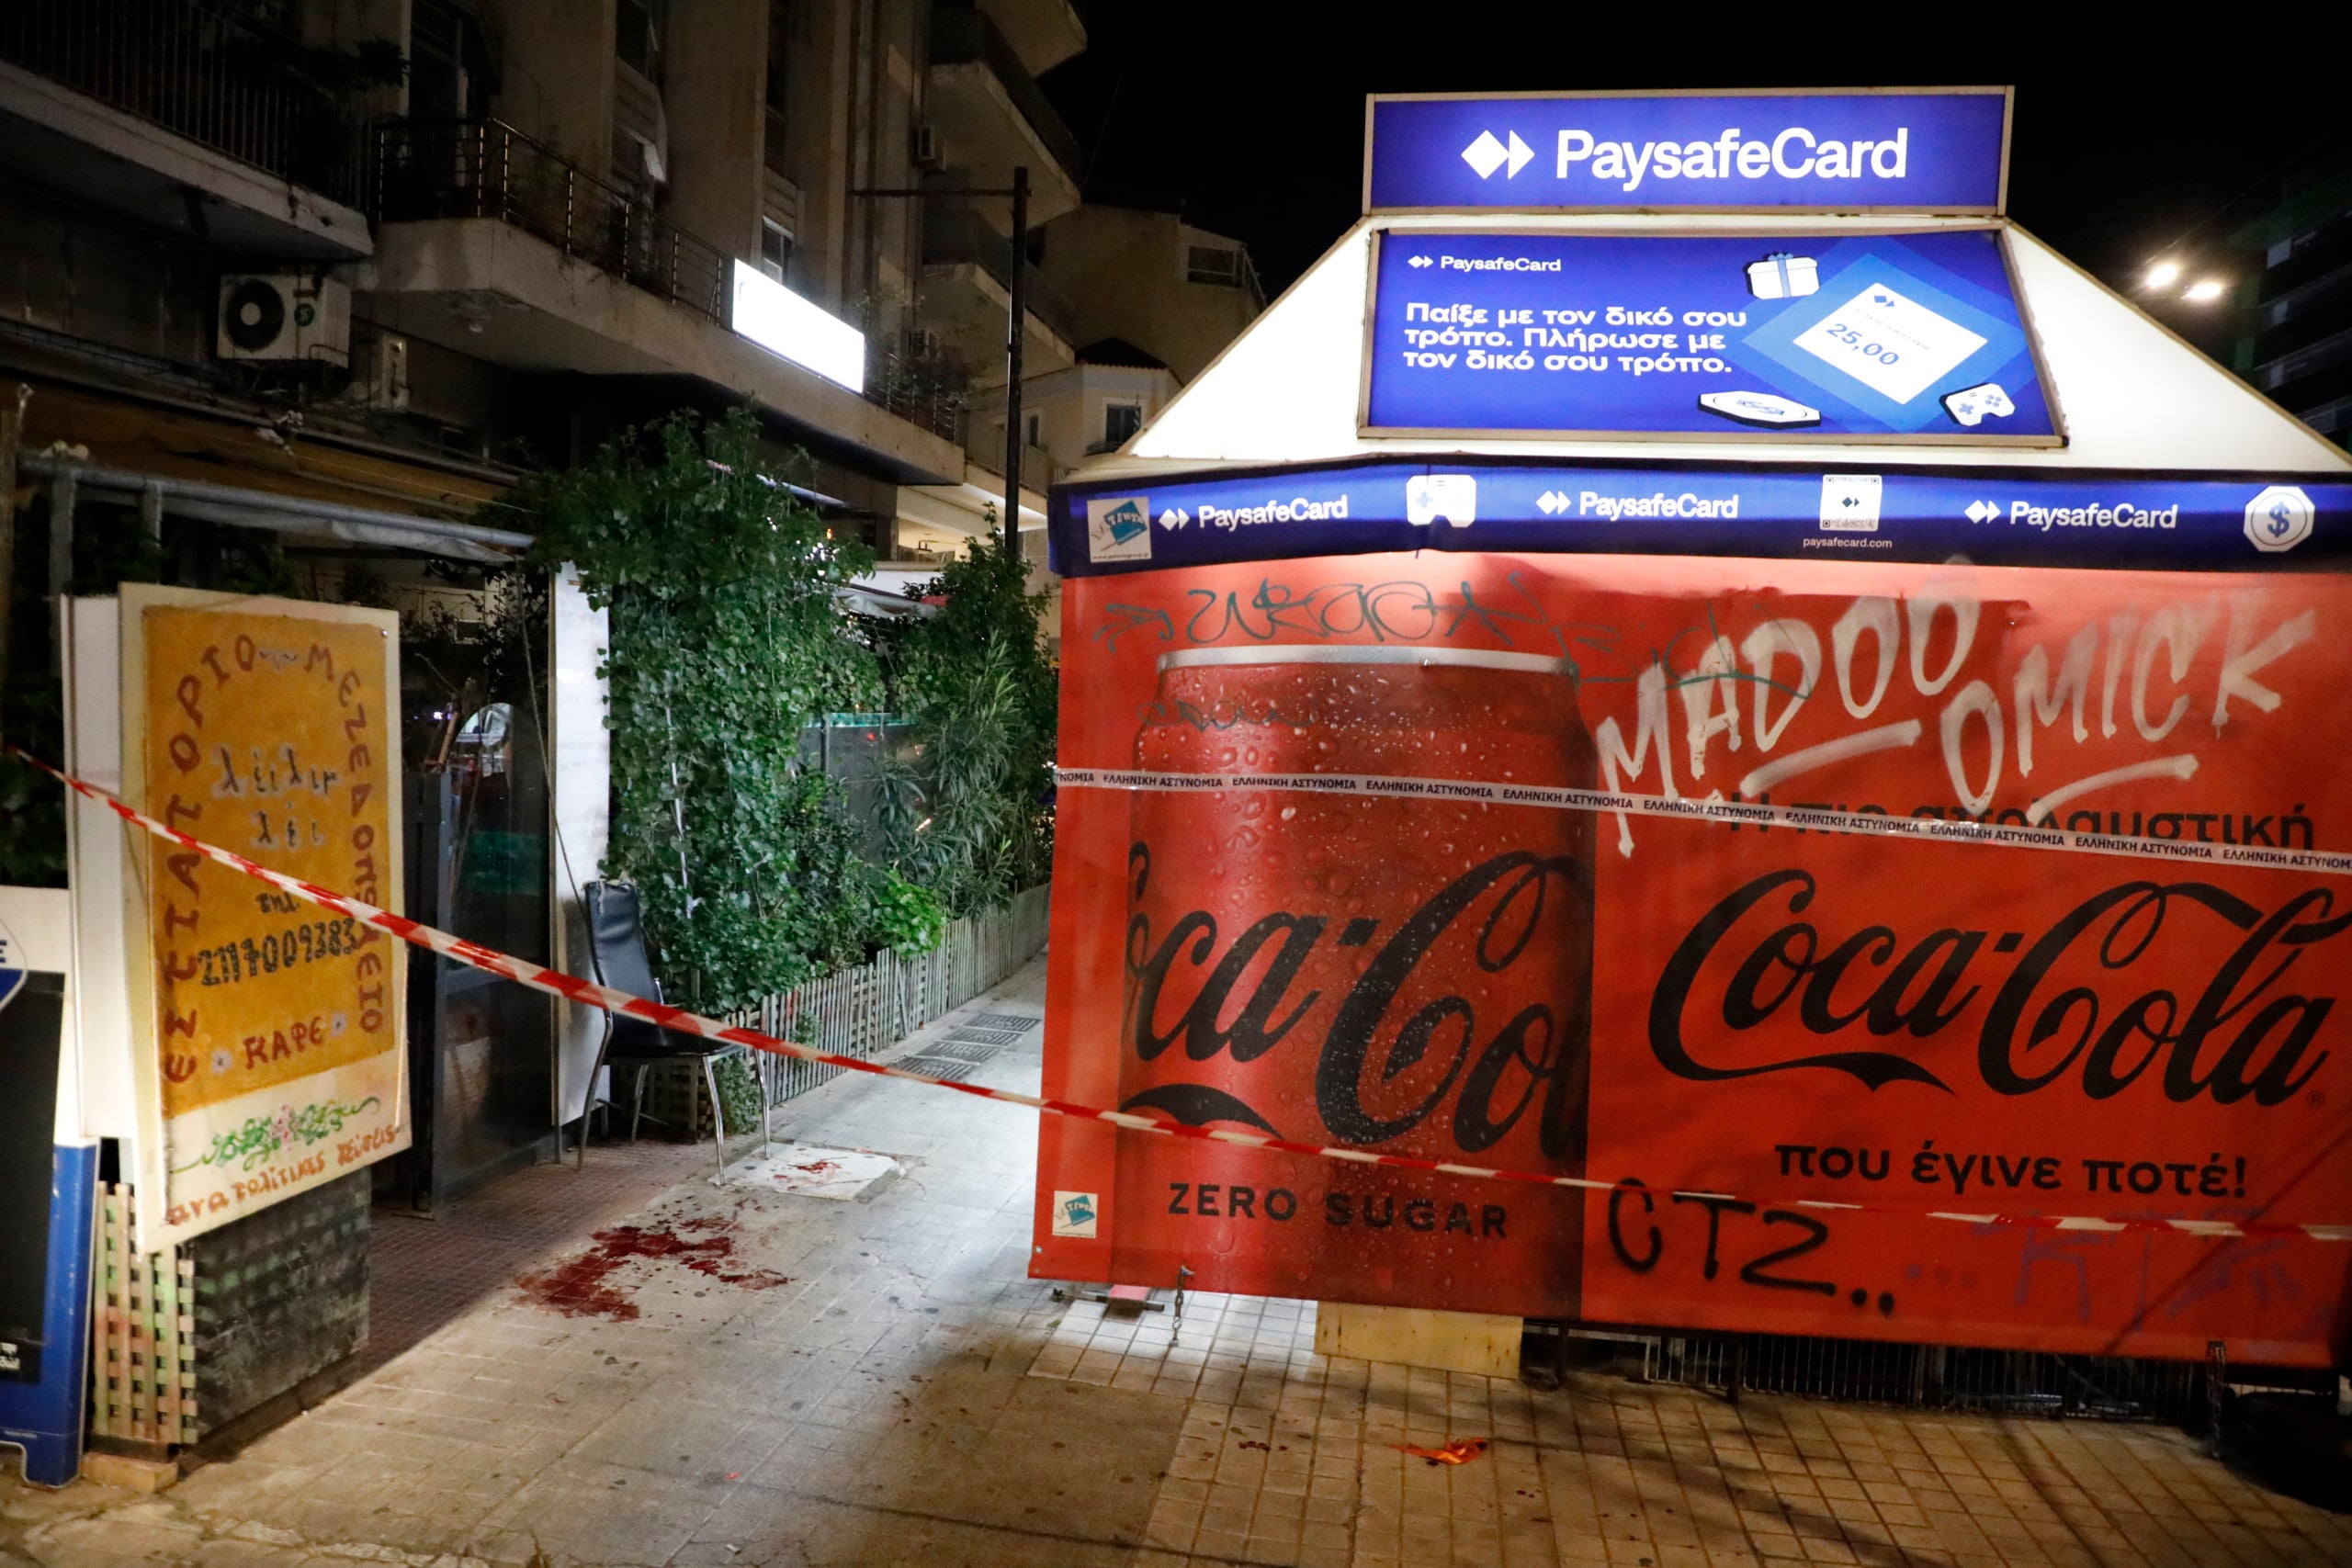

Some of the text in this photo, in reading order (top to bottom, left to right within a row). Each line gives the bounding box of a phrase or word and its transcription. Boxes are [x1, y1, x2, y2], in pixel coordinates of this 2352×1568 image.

[1555, 127, 1908, 191] PaysafeCard
[1440, 254, 1562, 273] PaysafeCard
[1406, 302, 1747, 328] Παίξε με τον δικό σου
[1404, 326, 1726, 353] τρόπο. Πλήρωσε με
[1825, 322, 1900, 366] 25,00
[1403, 349, 1733, 376] τον δικό σου τρόπο.
[1197, 495, 1349, 532] PaysafeCard
[1578, 491, 1739, 523] PaysafeCard
[2009, 502, 2178, 533] PaysafeCard
[1802, 536, 1893, 548] paysafecard.com
[1057, 772, 1094, 783] ΝΟΜΙΑ
[1103, 775, 1156, 786] ΕΛΛΗΝΙΚΗ
[1159, 777, 1223, 788] ΑΣΤΥΝΟΜΙΑ
[1232, 777, 1288, 787] ΕΛΛΗΝΙΚΗ
[1291, 778, 1356, 789] ΑΣΤΥΝΟΜΙΑ
[1366, 781, 1423, 794] ΕΛΛΗΝΙΚΗ
[1426, 784, 1493, 797] ΑΣΤΥΝΟΜΙΑ
[1503, 789, 1561, 803] ΕΛΛΗΝΙΚΗ
[1565, 794, 1633, 808] ΑΣΤΥΝΟΜΙΑ
[1644, 800, 1703, 814] ΕΛΛΗΝΙΚΗ
[1706, 806, 1775, 820] ΑΣΤΥΝΟΜΙΑ
[1786, 811, 1846, 826] ΕΛΛΗΝΙΚΗ
[1849, 818, 1919, 833] ΑΣΤΥΝΟΜΙΑ
[1930, 824, 1992, 840] ΕΛΛΗΝΙΚΗ
[1996, 830, 2064, 845] ΑΣΤΥΝΟΜΙΑ
[2075, 837, 2137, 852] ΕΛΛΗΝΙΚΗ
[2141, 842, 2212, 858] ΑΣΤΥΝΟΜΙΑ
[2223, 849, 2287, 863] ΕΛΛΗΝΙΚΗ
[1648, 868, 2352, 1108] Coca-Cola
[1774, 1140, 2248, 1198] που έγινε ποτέ!
[1168, 1182, 1508, 1239] ZERO SUGAR
